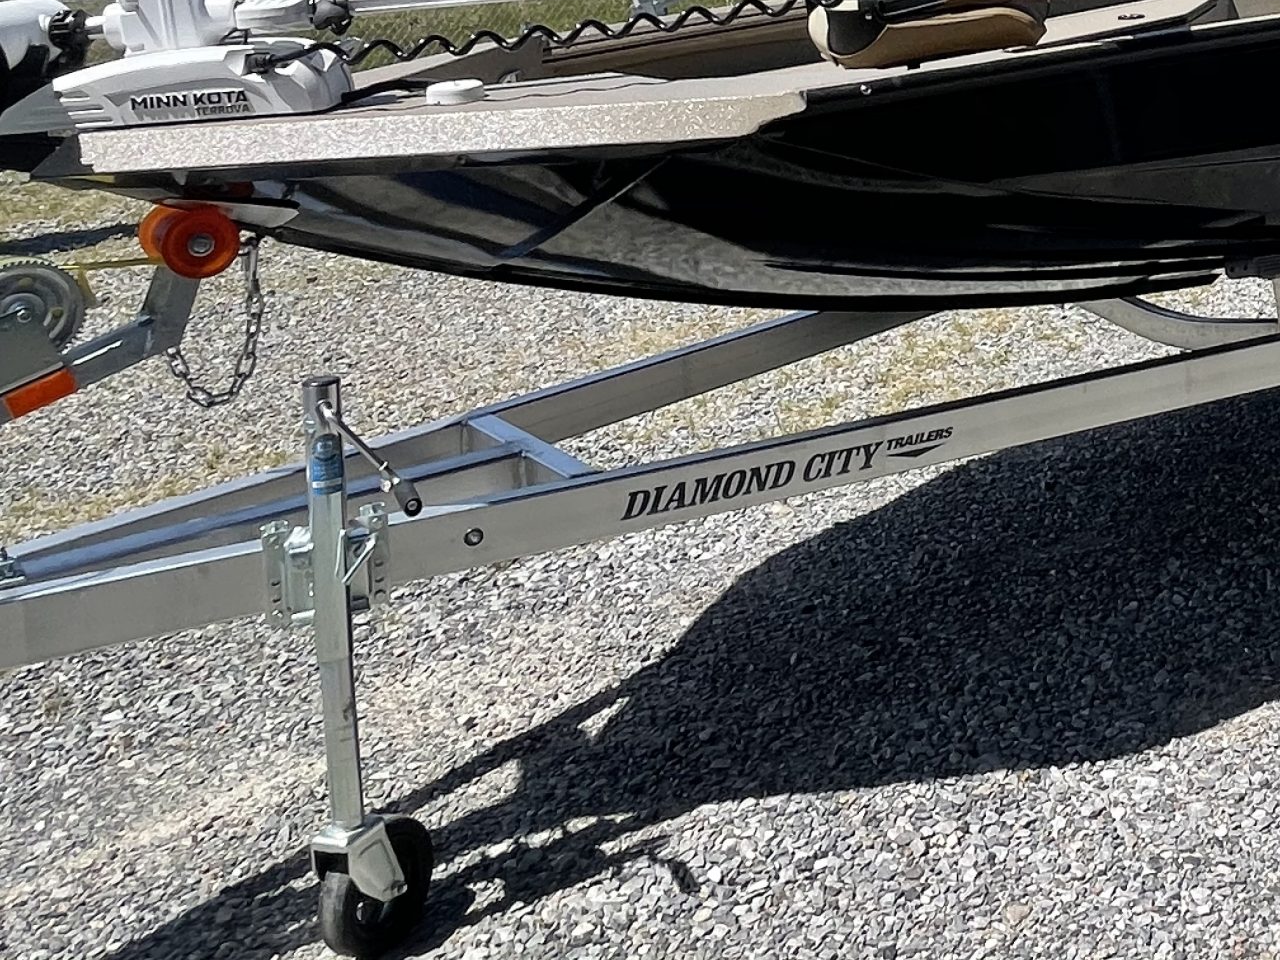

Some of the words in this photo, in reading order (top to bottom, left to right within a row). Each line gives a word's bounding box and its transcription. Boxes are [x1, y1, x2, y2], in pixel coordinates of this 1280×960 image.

[130, 95, 188, 110] MINN
[192, 90, 248, 106] KOTA
[195, 104, 250, 116] TERROVA
[886, 426, 954, 451] TRAILERS
[620, 459, 797, 520] DIAMOND
[803, 440, 885, 482] CITY
